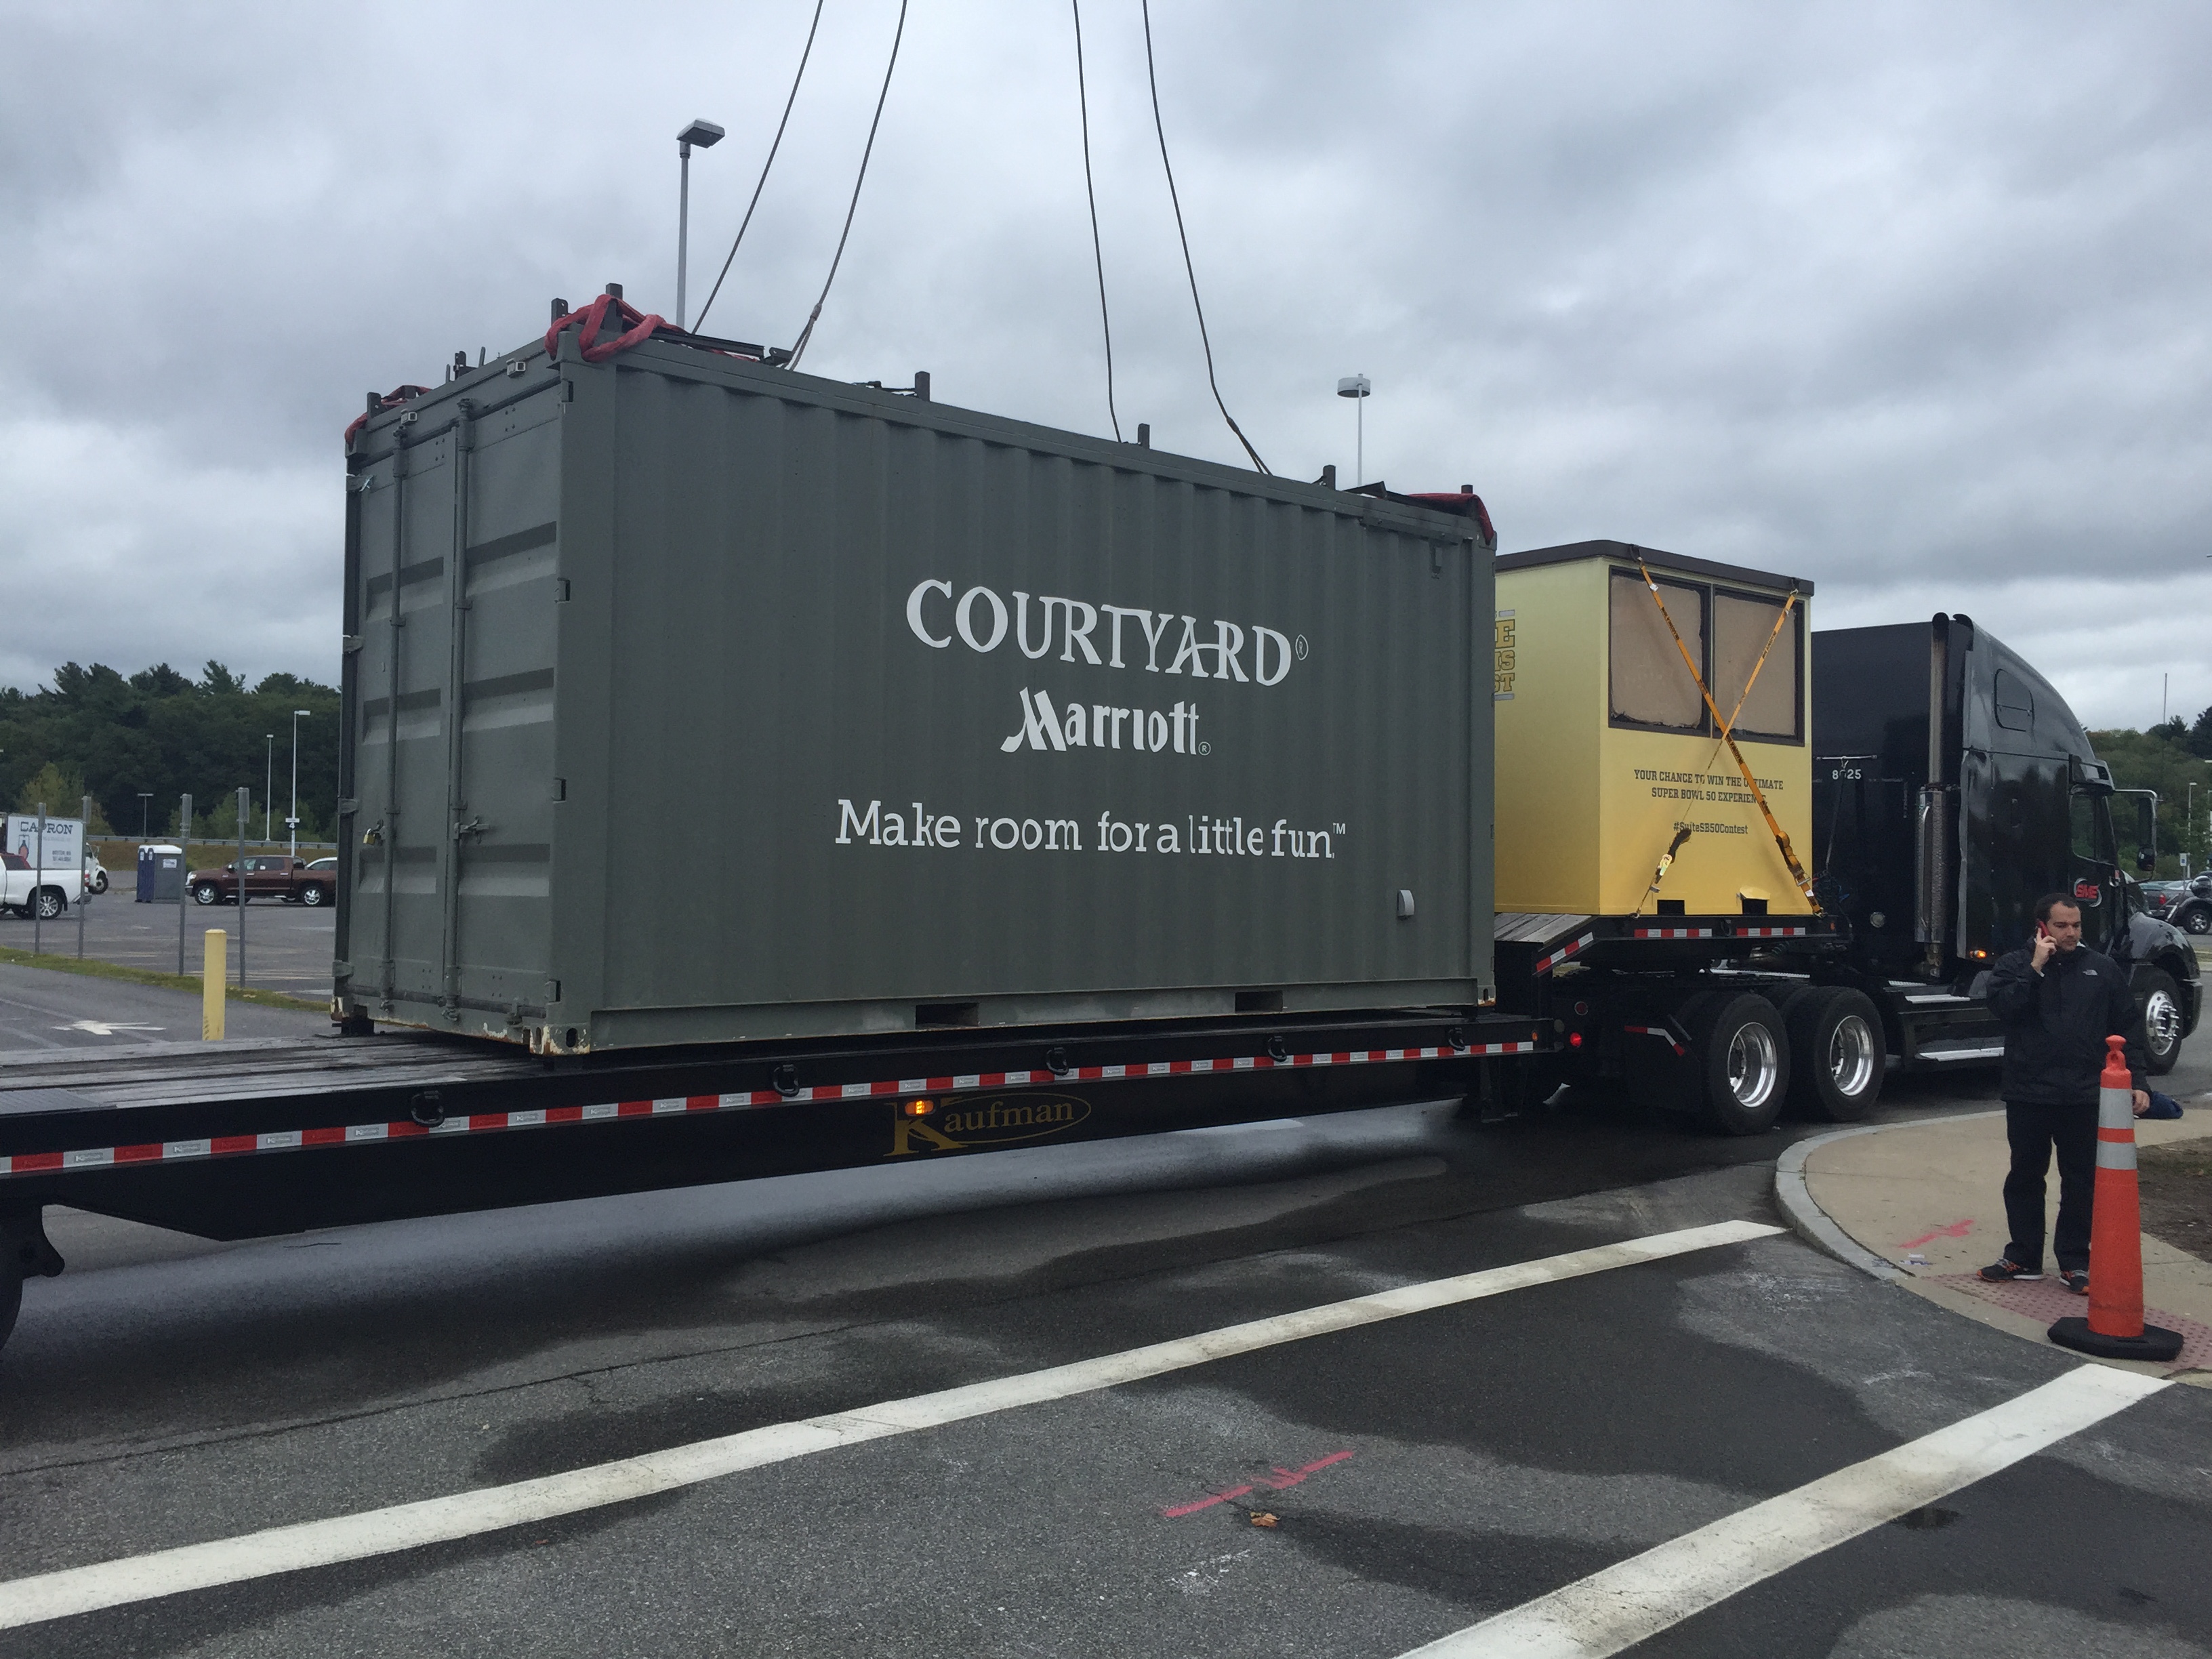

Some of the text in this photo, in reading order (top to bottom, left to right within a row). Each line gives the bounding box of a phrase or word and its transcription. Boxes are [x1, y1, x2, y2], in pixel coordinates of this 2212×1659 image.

[1634, 769, 1784, 790] YOUR CHANCE TO WIN THE UTIMATE
[1652, 787, 1767, 804] SUPER BOWL 50 EXPERIEN
[20, 821, 73, 834] CARON
[834, 798, 961, 848] Make
[974, 817, 1082, 851] room
[1097, 811, 1149, 853] for
[1156, 823, 1181, 853] a
[1188, 815, 1263, 857] little
[2076, 884, 2100, 899] SME
[883, 1096, 1074, 1156] Kaufman
